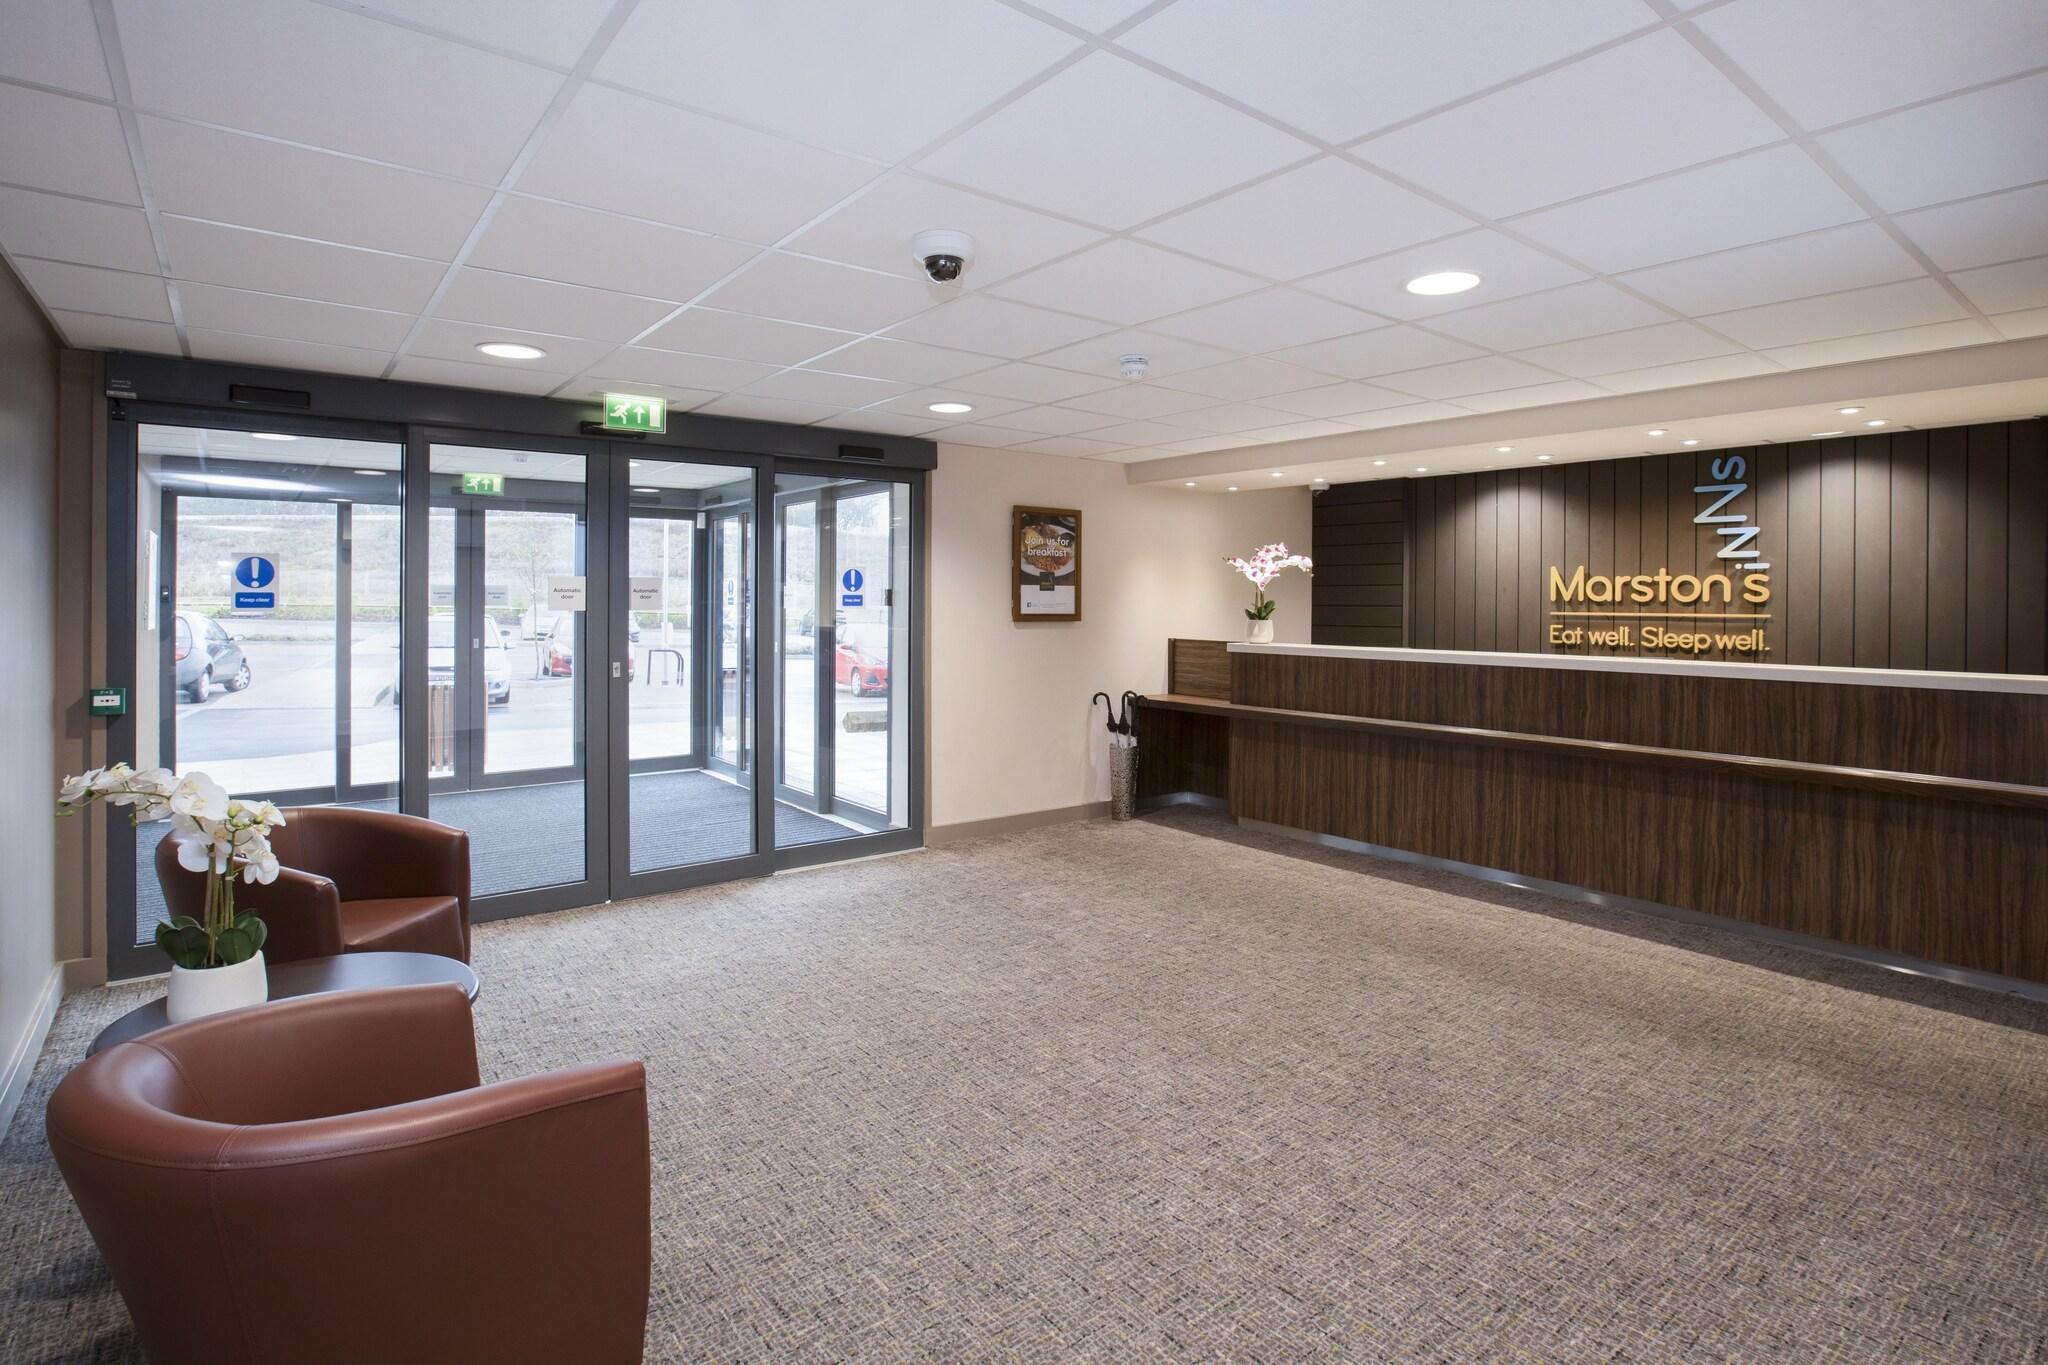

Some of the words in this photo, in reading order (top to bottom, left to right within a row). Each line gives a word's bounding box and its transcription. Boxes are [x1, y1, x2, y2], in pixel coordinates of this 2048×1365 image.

[1025, 536, 1044, 545] Join
[1056, 537, 1069, 546] for
[1027, 547, 1067, 557] breakfast
[1550, 625, 1583, 644] Eat
[1588, 626, 1635, 646] well.
[1641, 626, 1711, 653] Sleep
[1715, 629, 1770, 651] well.
